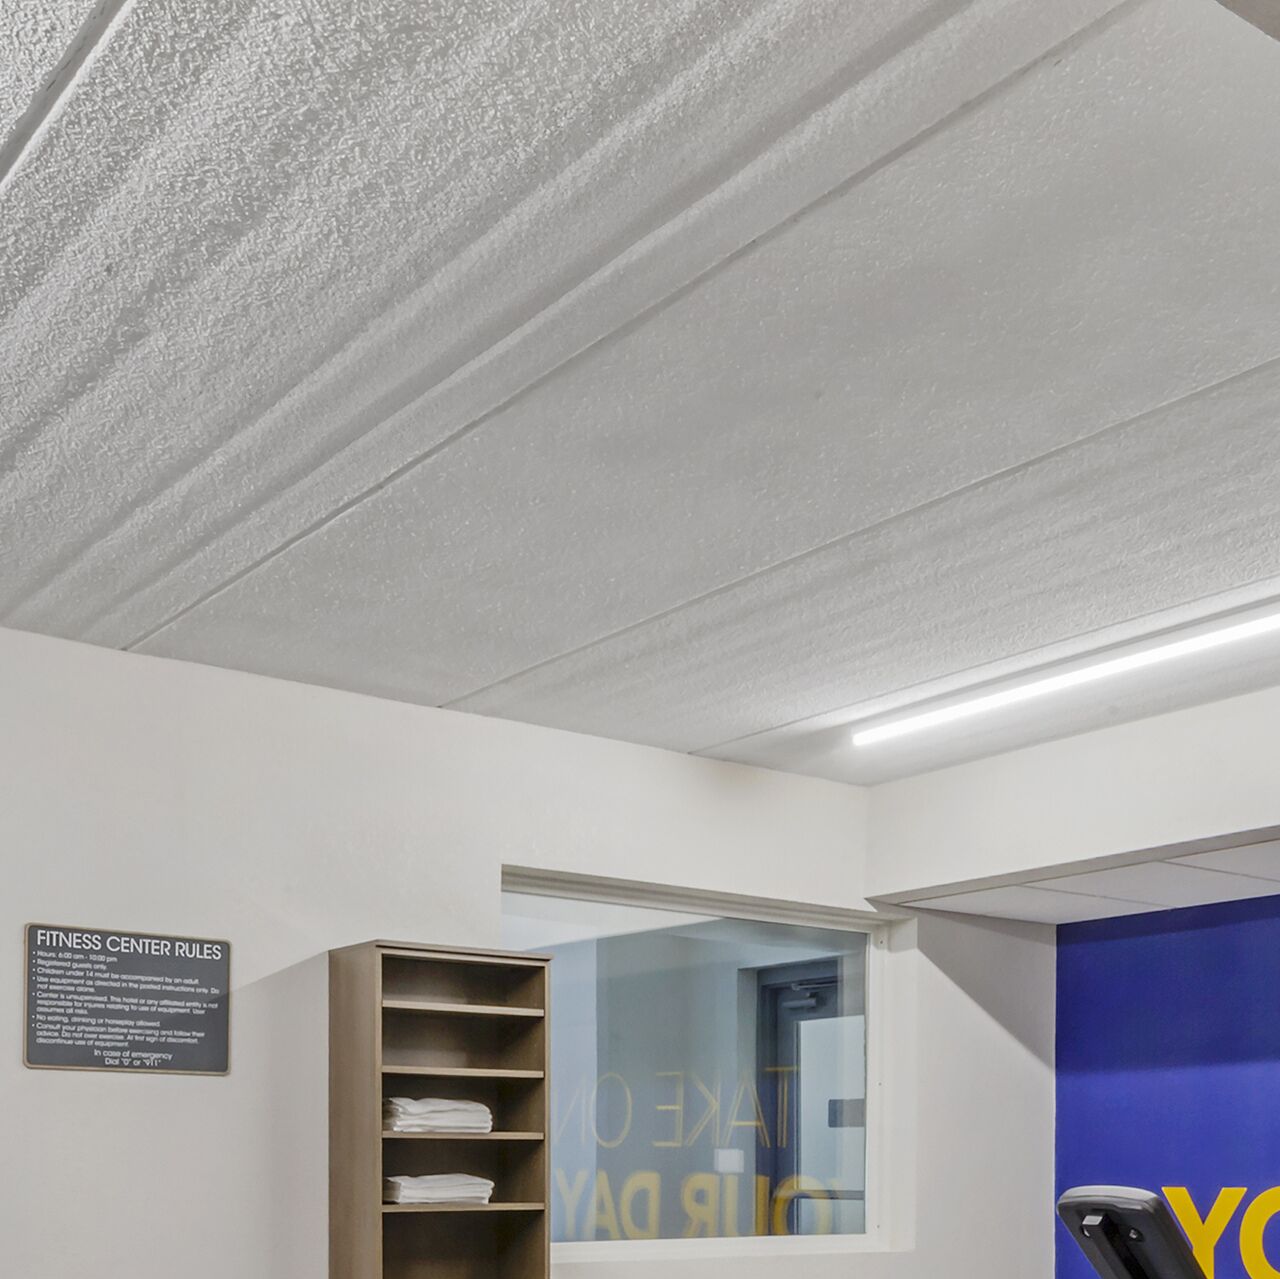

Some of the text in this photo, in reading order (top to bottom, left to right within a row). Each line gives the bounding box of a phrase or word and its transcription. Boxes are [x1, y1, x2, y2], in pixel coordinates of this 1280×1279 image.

[37, 930, 222, 960] FITNESS CENTER RULES
[37, 959, 71, 968] Registered
[37, 967, 64, 975] Children
[65, 969, 84, 977] under
[50, 977, 85, 986] equipment
[37, 991, 58, 999] Center
[122, 1050, 130, 1058] of
[131, 1052, 173, 1061] emergency
[104, 1057, 119, 1065] Dial
